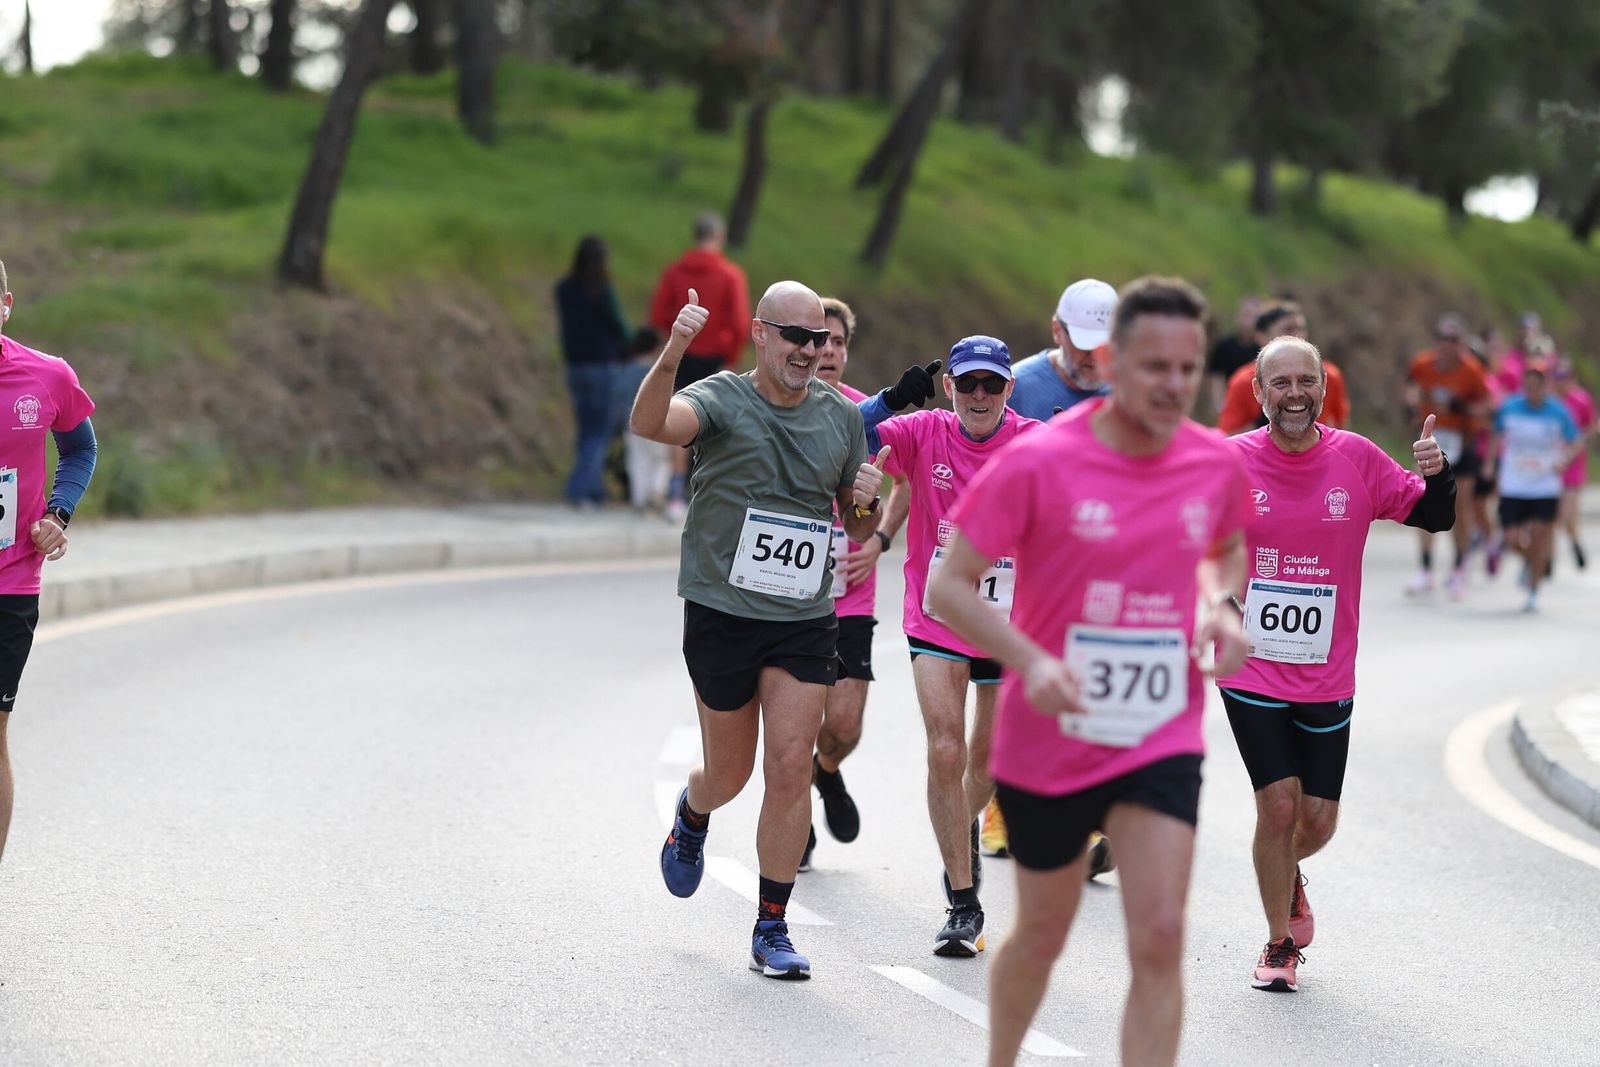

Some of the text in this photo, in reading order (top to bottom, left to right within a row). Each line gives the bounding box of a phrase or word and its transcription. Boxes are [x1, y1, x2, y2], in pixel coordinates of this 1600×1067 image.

[752, 533, 815, 570] 540
[1283, 555, 1319, 565] Ciudad
[1283, 565, 1330, 577] de Málaga
[1260, 603, 1322, 635] 600
[1089, 660, 1171, 703] 370
